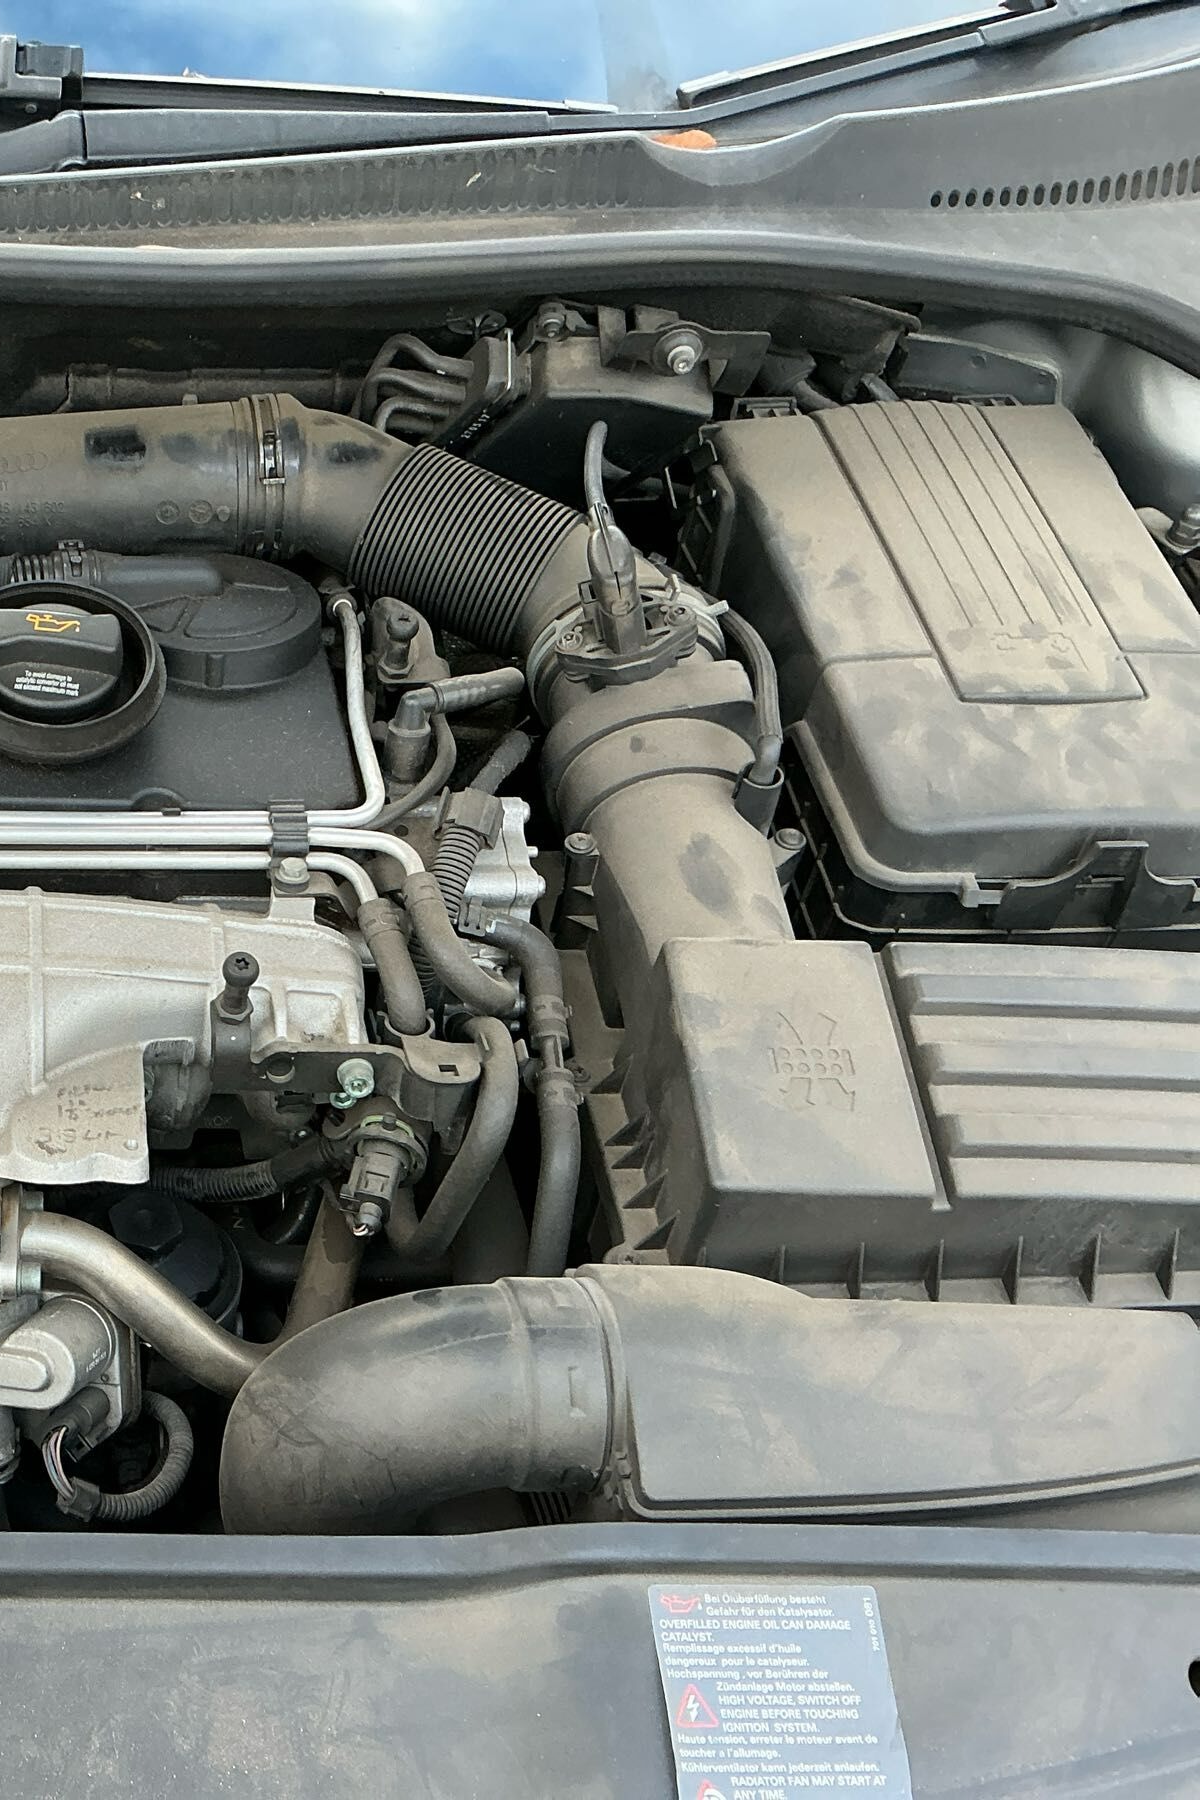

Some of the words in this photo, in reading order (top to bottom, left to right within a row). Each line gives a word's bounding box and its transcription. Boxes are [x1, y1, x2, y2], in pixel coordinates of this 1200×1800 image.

[704, 1593, 720, 1604] Bei
[789, 1595, 826, 1605] besteht
[706, 1606, 739, 1616] Gefahr
[741, 1606, 755, 1616] für
[757, 1606, 777, 1616] den
[777, 1607, 835, 1618] Katalysator.
[660, 1619, 720, 1630] OVERFILLED
[723, 1620, 761, 1629] ENGINE
[763, 1620, 780, 1630] OIL
[781, 1620, 804, 1630] CAN
[806, 1620, 851, 1630] DAMAGE
[661, 1632, 715, 1642] CATALYST.
[662, 1643, 725, 1655] Remplissage
[727, 1643, 766, 1653] excessif
[665, 1656, 717, 1667] dangereux
[721, 1658, 744, 1668] pour
[746, 1656, 756, 1666] le
[757, 1656, 809, 1668] catalyseur.
[747, 1670, 763, 1679] vor
[765, 1668, 810, 1679] Berühren
[812, 1668, 828, 1679] der
[716, 1682, 774, 1693] Zündanlage
[776, 1682, 805, 1692] Motor
[808, 1682, 855, 1692] abstellen.
[718, 1695, 745, 1705] HIGH
[798, 1695, 839, 1705] SWITCH
[841, 1695, 862, 1705] OFF
[720, 1709, 759, 1719] ENGINE
[762, 1709, 800, 1719] BEFORE
[803, 1709, 859, 1719] TOUCHING
[722, 1722, 769, 1732] IGNITION
[774, 1722, 821, 1733] SYSTEM.
[678, 1734, 706, 1744] Haute
[785, 1734, 795, 1744] le
[797, 1735, 832, 1744] moteur
[835, 1735, 863, 1745] avant
[864, 1734, 878, 1744] de
[680, 1747, 716, 1758] toucher
[681, 1762, 759, 1773] Kühlerventilator
[761, 1762, 786, 1772] kann
[788, 1762, 832, 1774] jederzeit
[834, 1762, 880, 1772] anlaufen.
[731, 1776, 786, 1786] RADIATOR
[788, 1776, 809, 1786] FAN
[811, 1776, 835, 1786] MAY
[837, 1775, 871, 1786] START
[873, 1775, 887, 1785] AT
[734, 1790, 756, 1800] ANY
[758, 1790, 787, 1800] TIME.
